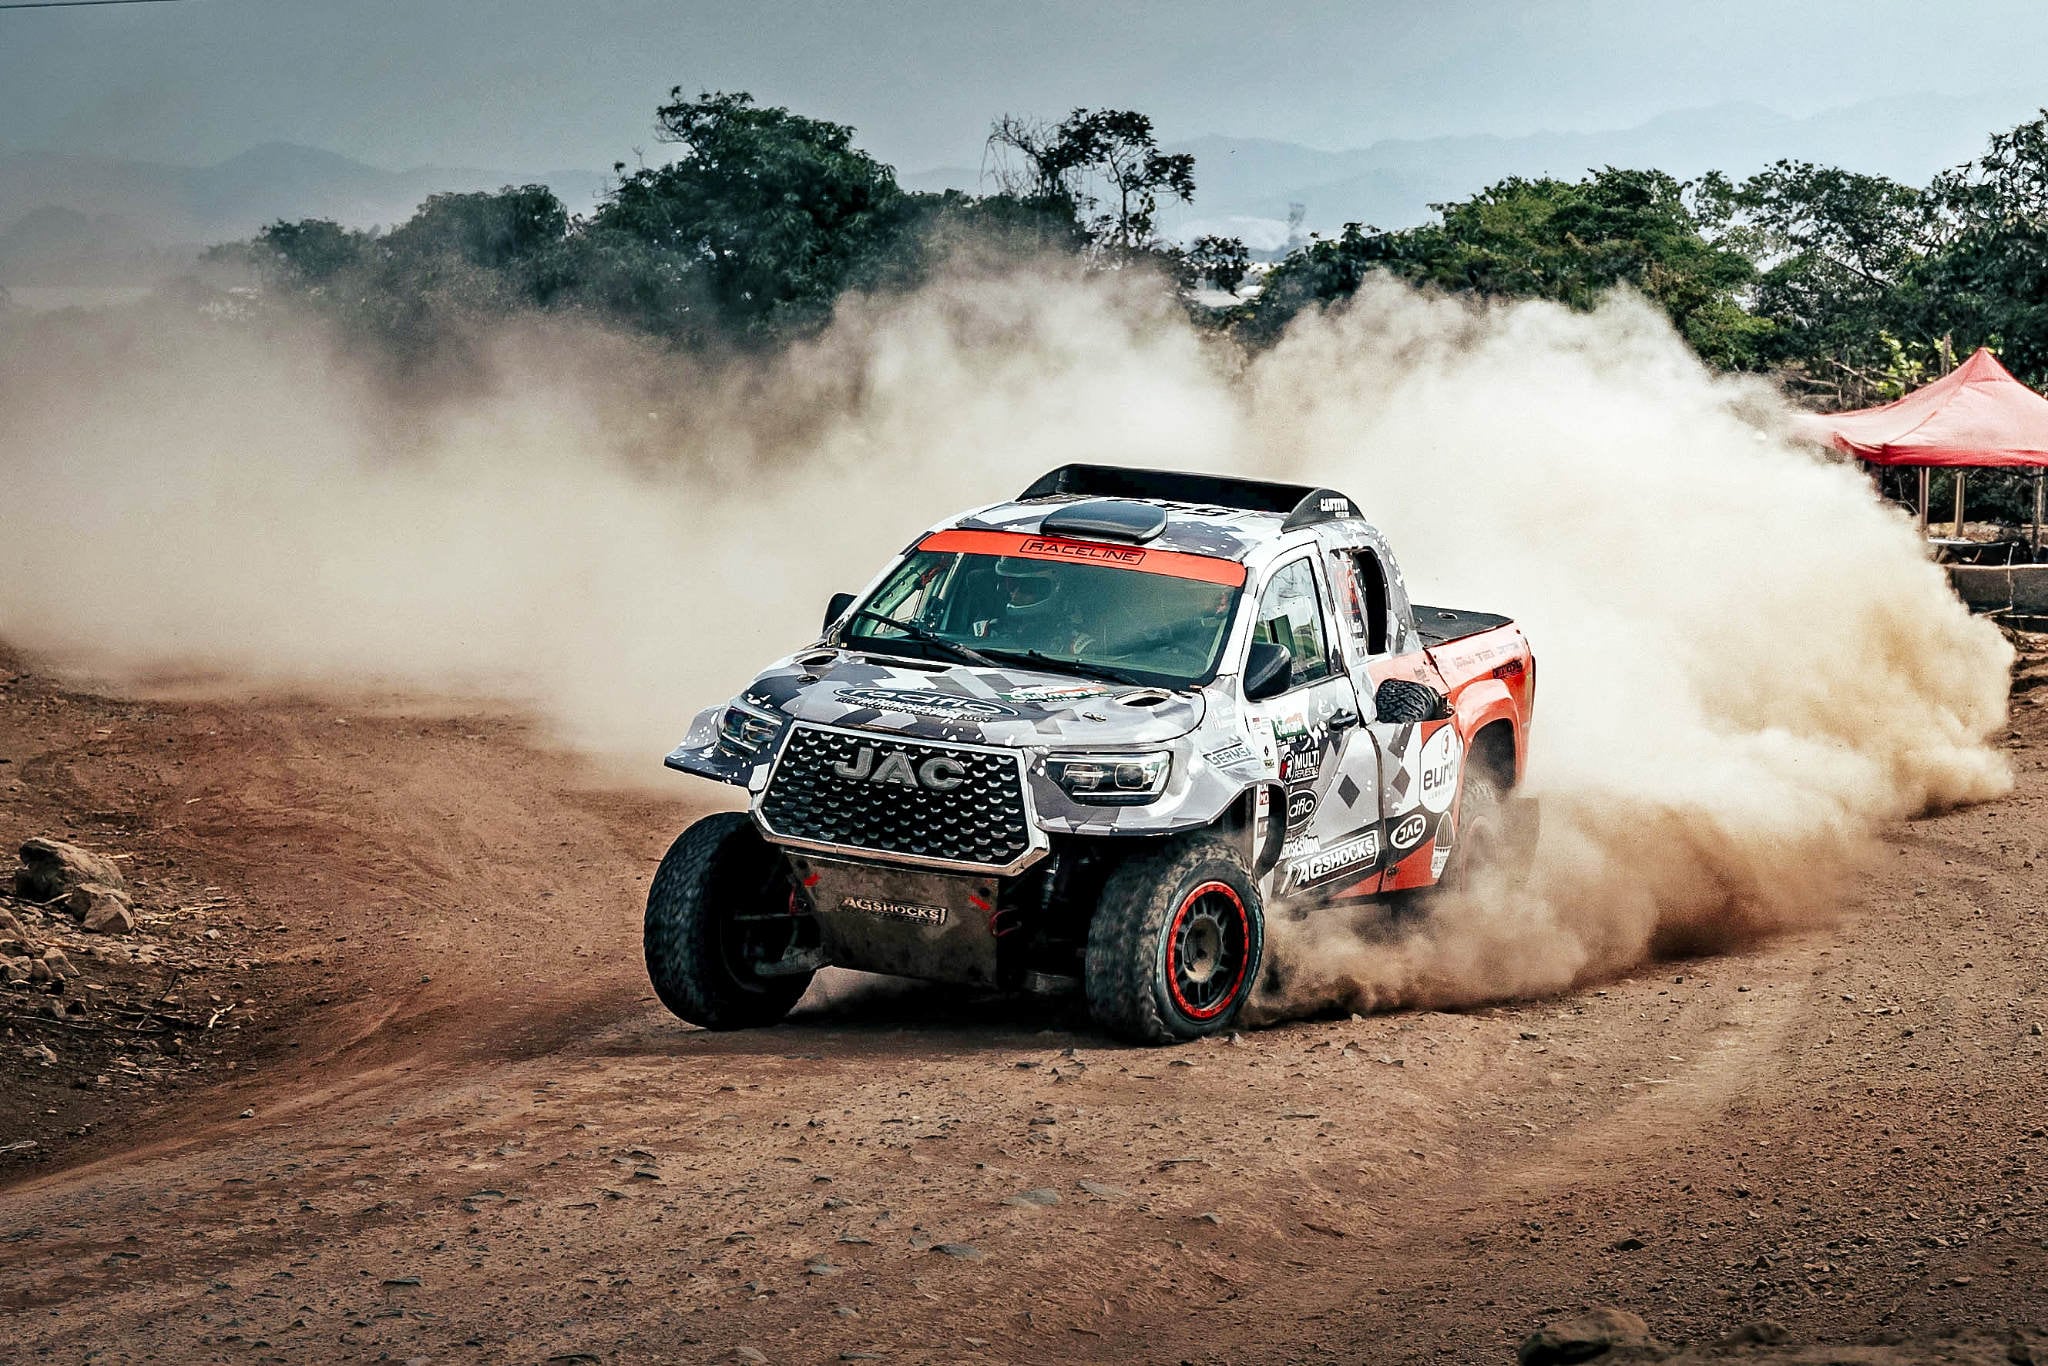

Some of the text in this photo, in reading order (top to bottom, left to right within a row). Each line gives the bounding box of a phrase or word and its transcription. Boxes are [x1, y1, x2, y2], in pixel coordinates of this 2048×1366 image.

[1027, 541, 1136, 562] RACELINE
[834, 746, 966, 790] JAC
[1294, 749, 1320, 770] MULTI
[1398, 817, 1423, 841] JAC
[1296, 838, 1375, 886] AGSHOCKS
[841, 896, 940, 920] AGSHOCKS
